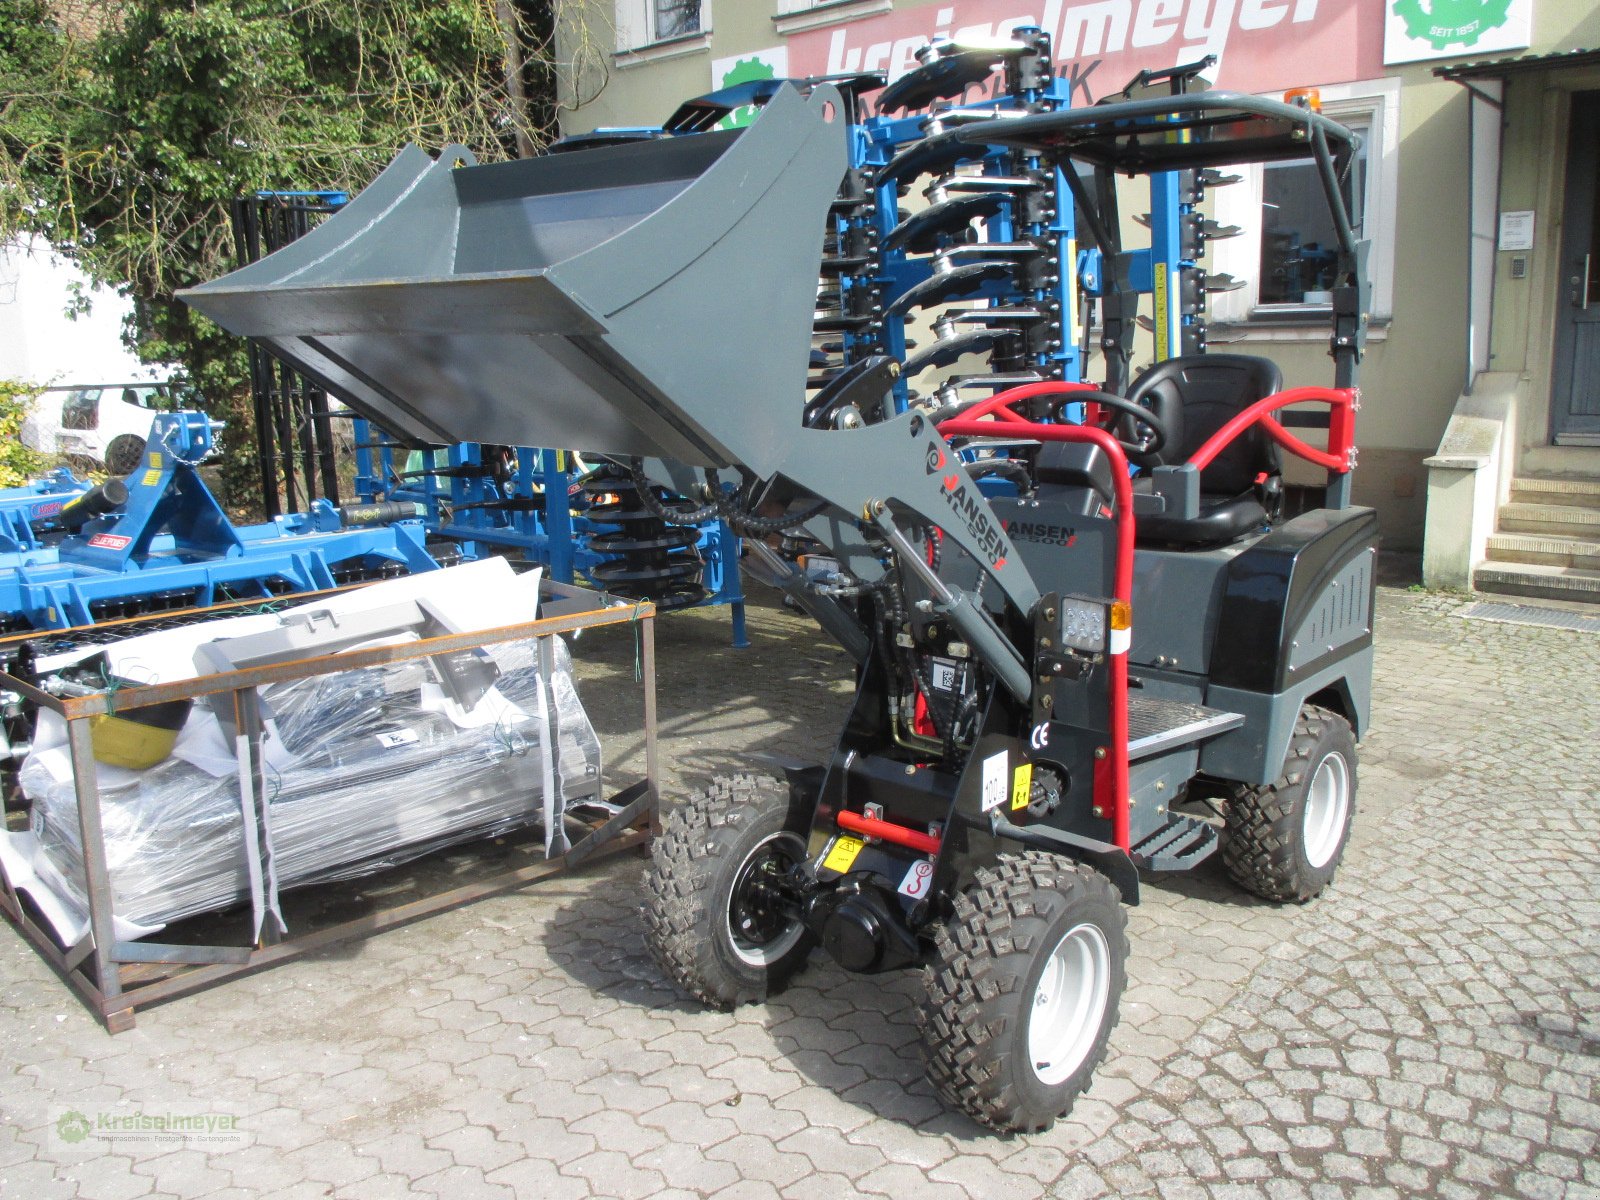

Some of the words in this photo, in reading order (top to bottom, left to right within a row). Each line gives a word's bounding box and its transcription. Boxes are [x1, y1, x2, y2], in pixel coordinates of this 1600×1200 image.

[825, 0, 1319, 86] krelmeye
[1429, 26, 1453, 38] SEIT
[1455, 19, 1480, 37] 1857
[939, 484, 998, 566] HL-500
[943, 473, 1009, 560] JANSEN
[1009, 534, 1069, 547] L-500
[1031, 721, 1050, 750] CE
